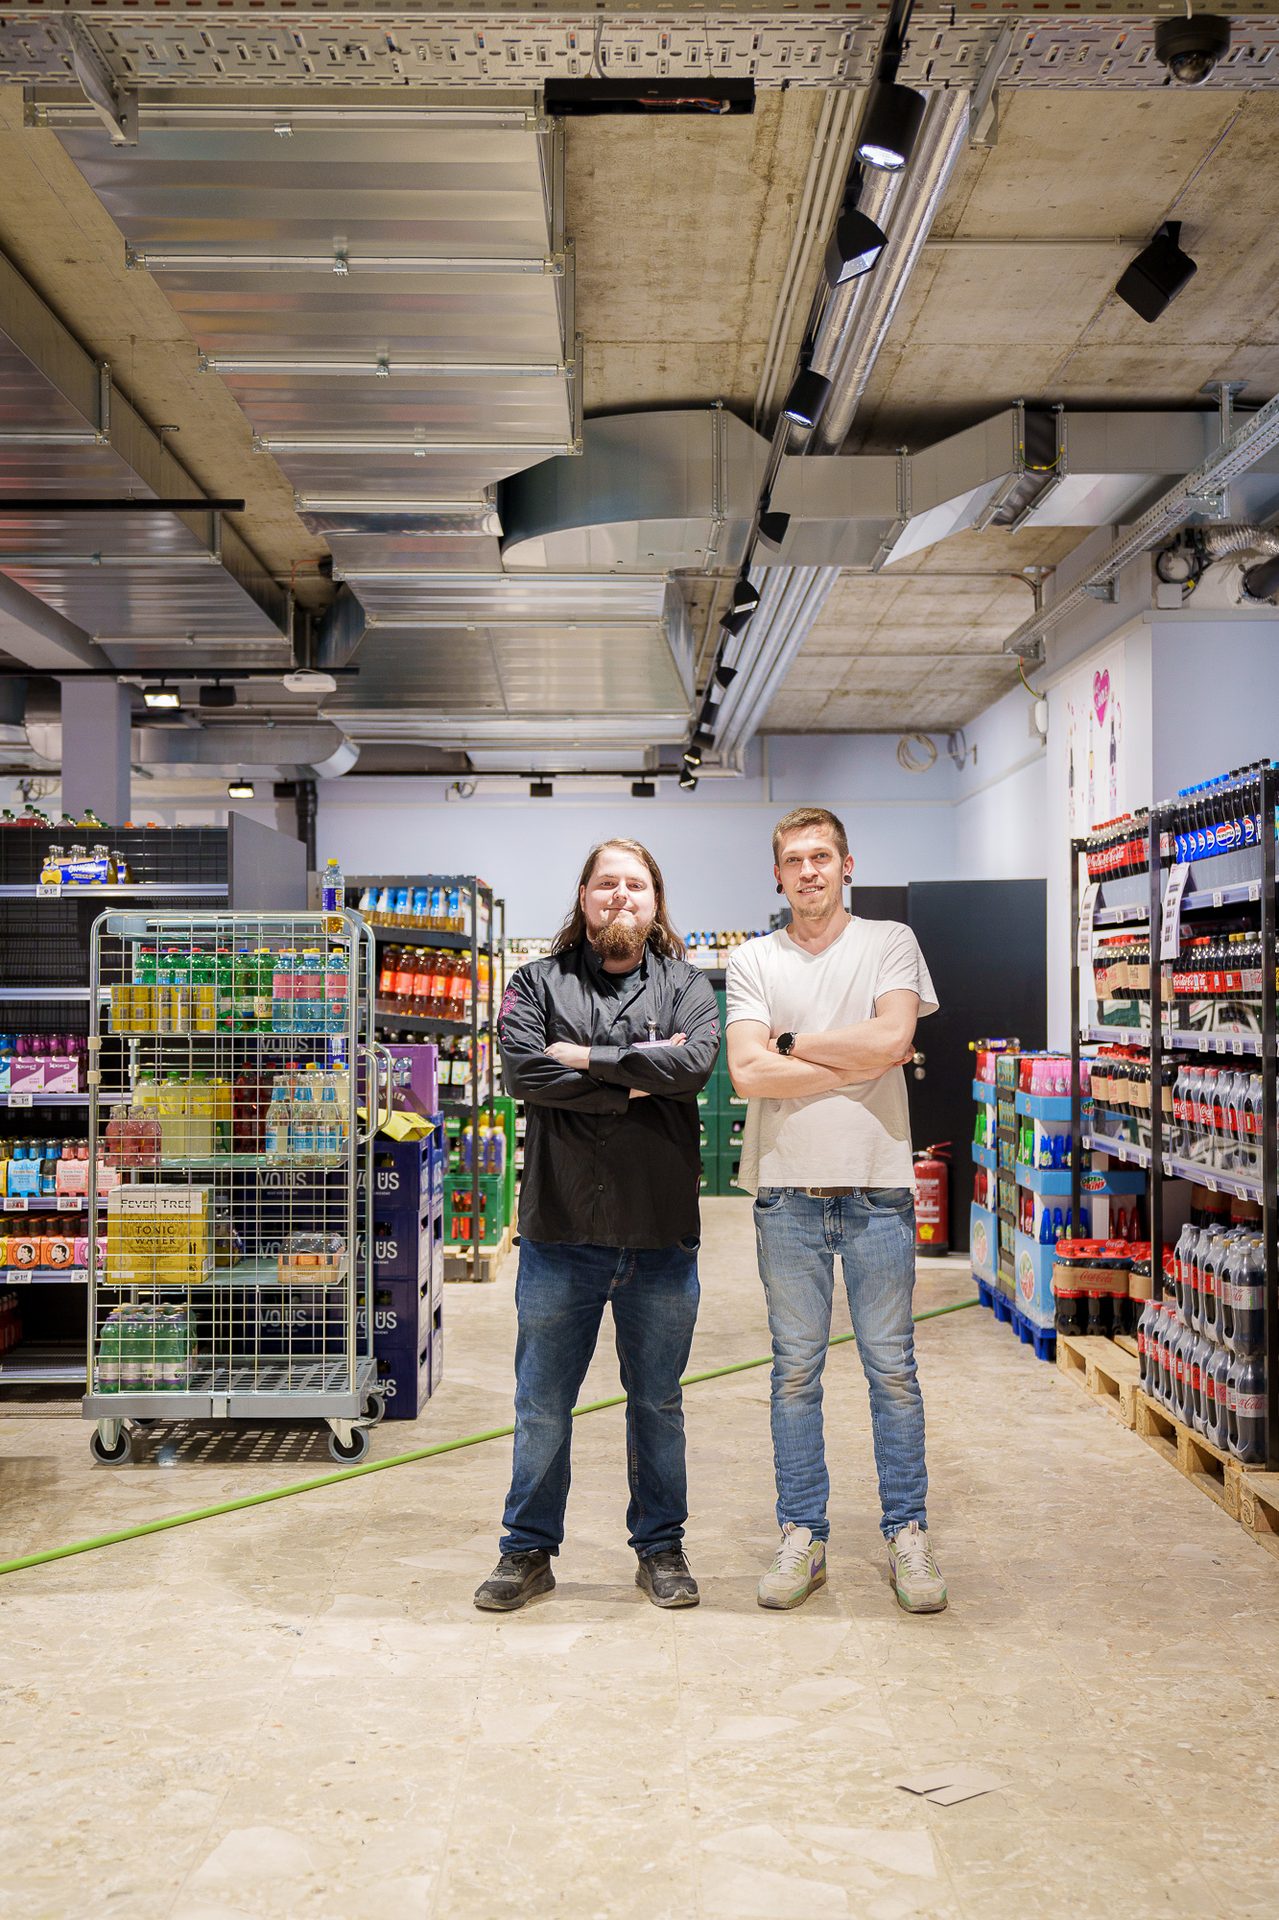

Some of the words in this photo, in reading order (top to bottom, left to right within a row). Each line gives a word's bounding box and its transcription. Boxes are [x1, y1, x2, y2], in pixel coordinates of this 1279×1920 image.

[121, 1199, 157, 1209] FEVER
[161, 1199, 191, 1209] TREE
[137, 1226, 174, 1235] TONIC
